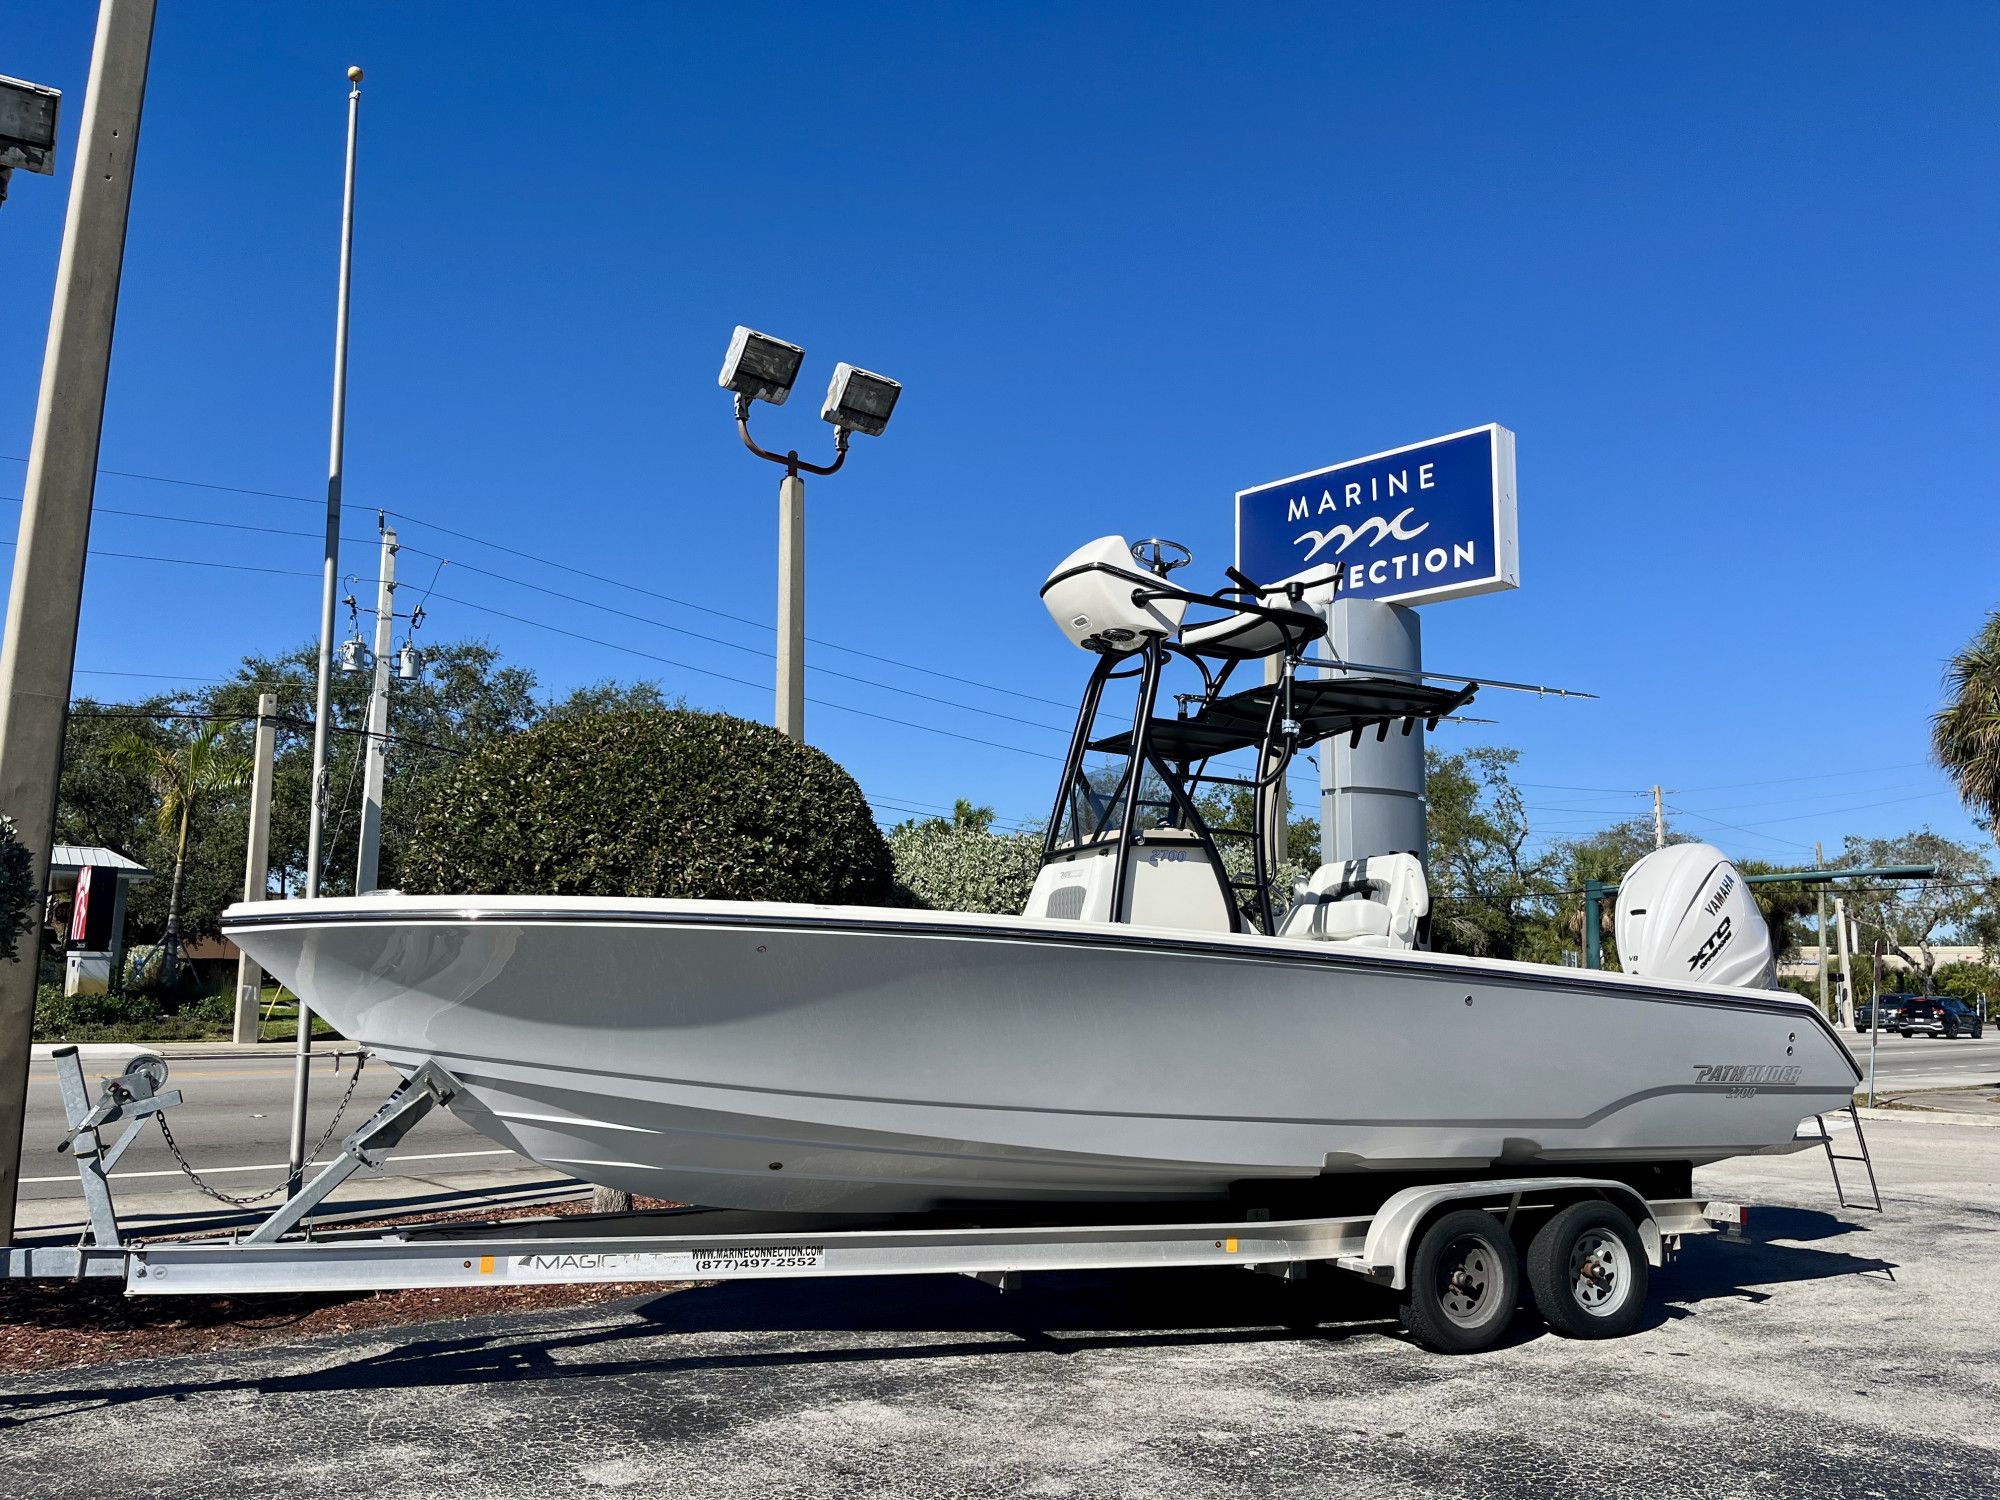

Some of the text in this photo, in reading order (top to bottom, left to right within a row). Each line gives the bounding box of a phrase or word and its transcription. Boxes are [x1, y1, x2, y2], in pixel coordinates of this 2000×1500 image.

[1287, 462, 1435, 522] MARINE
[1337, 540, 1475, 592] ECTION
[1150, 849, 1187, 862] 2700
[1704, 873, 1735, 917] YAMAHA
[1687, 915, 1731, 972] XTO
[1692, 1064, 1803, 1083] PATHFINDER
[1725, 1087, 1757, 1099] 2700
[691, 1245, 824, 1260] WWW.MARINECONNECTION.COM
[695, 1257, 817, 1272] (877)497-2552
